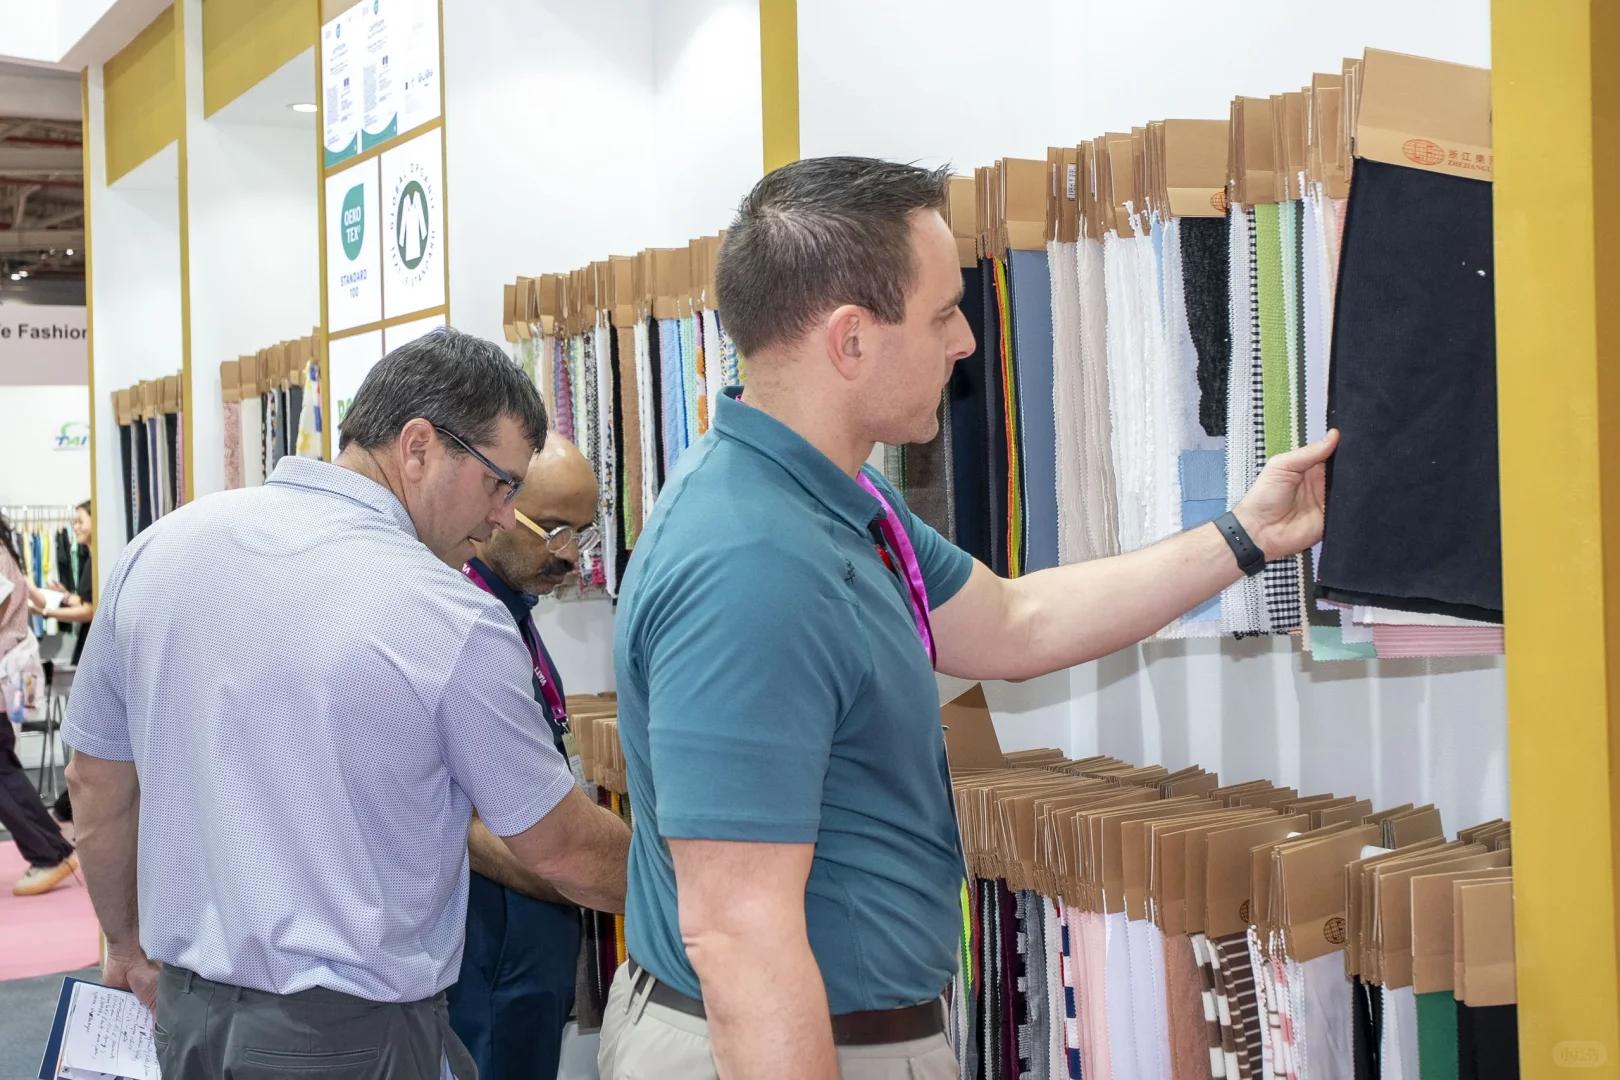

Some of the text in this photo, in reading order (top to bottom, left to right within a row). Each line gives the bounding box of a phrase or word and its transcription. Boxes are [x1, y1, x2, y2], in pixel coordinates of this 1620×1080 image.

[344, 206, 361, 227] OEKO
[341, 269, 367, 287] STANDARD
[350, 287, 359, 298] 100
[534, 667, 547, 687] VIATT
